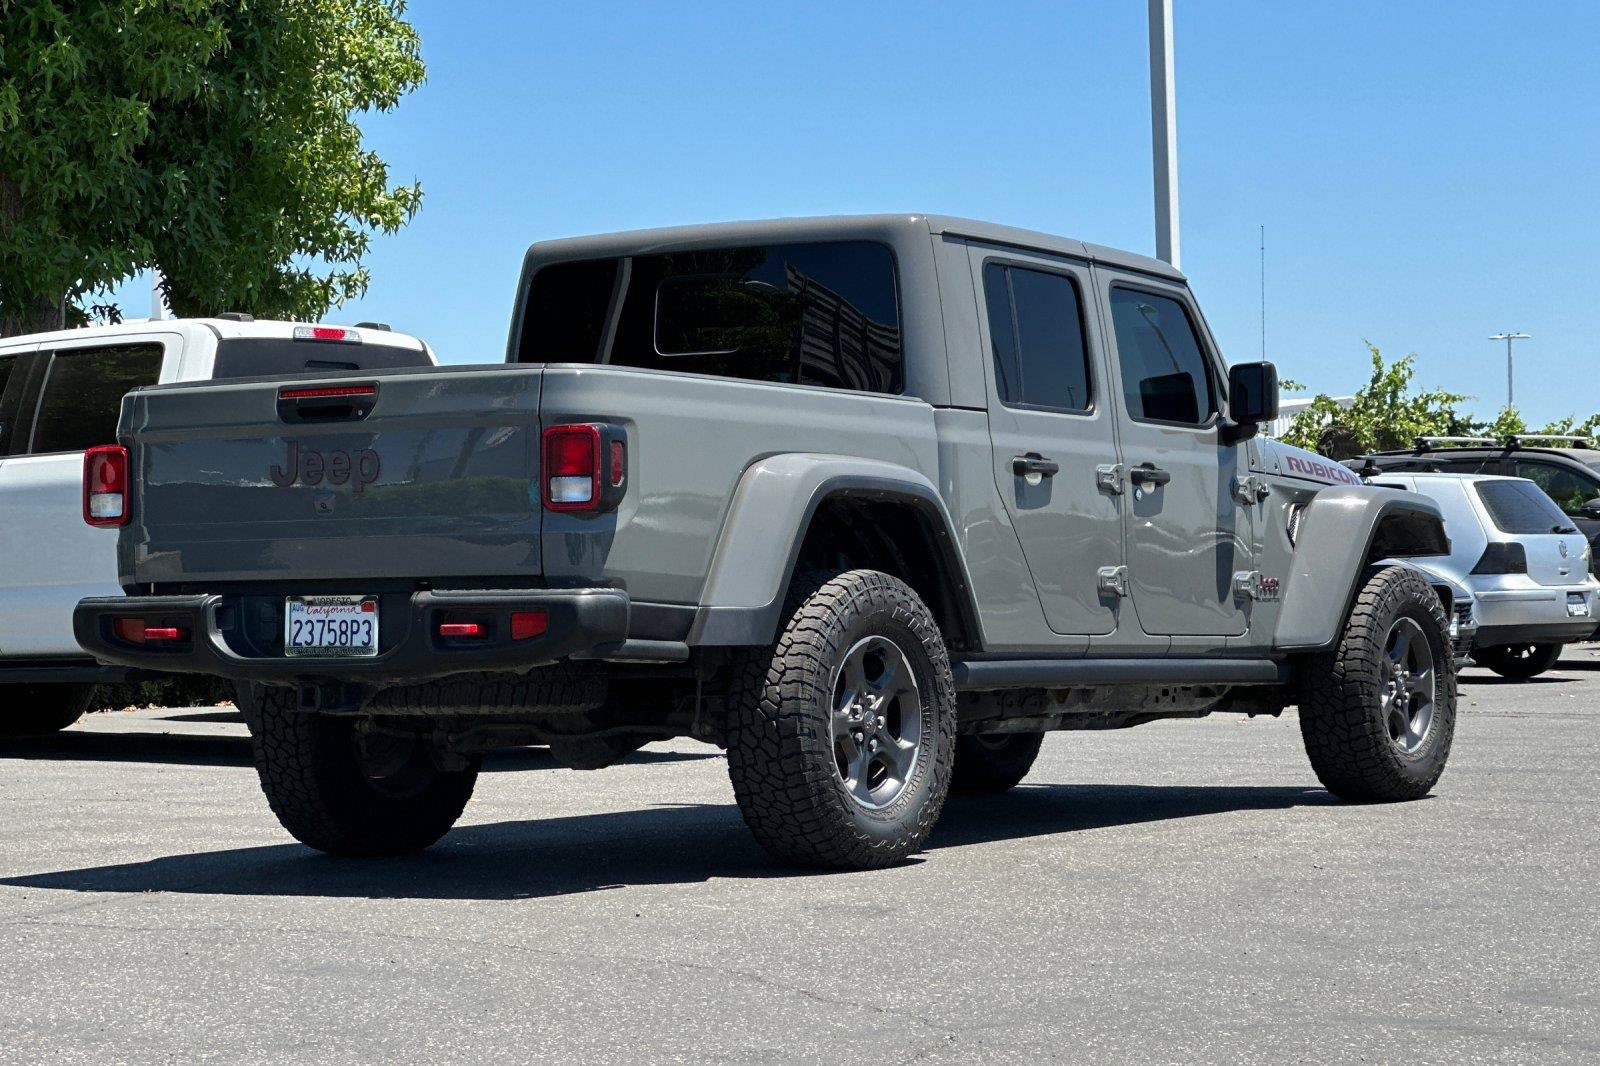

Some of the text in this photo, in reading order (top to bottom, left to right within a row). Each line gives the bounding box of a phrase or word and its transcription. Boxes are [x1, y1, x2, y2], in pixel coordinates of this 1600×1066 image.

[270, 440, 380, 493] Jeep
[306, 605, 361, 618] California
[293, 620, 372, 646] 23758P3
